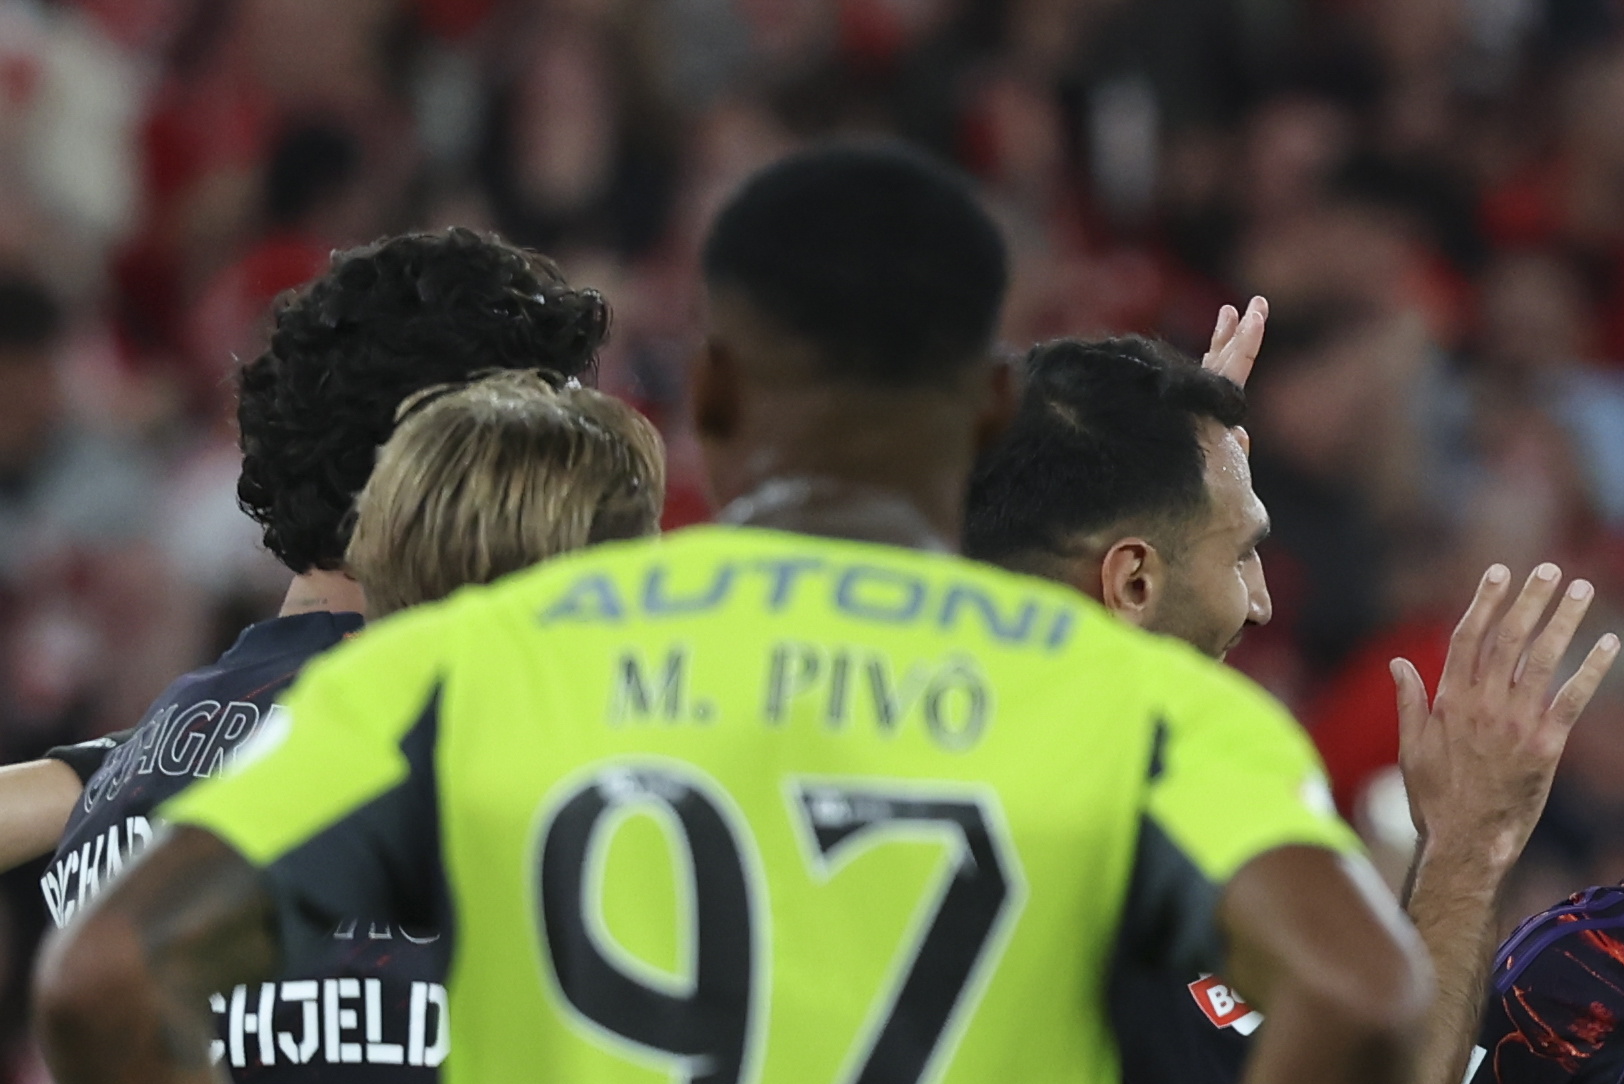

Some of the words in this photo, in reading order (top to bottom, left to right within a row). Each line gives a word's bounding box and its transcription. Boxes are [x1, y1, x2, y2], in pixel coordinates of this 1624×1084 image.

[537, 558, 1076, 652] AUTONI
[606, 642, 716, 730] M.
[764, 641, 992, 753] PIVÔ
